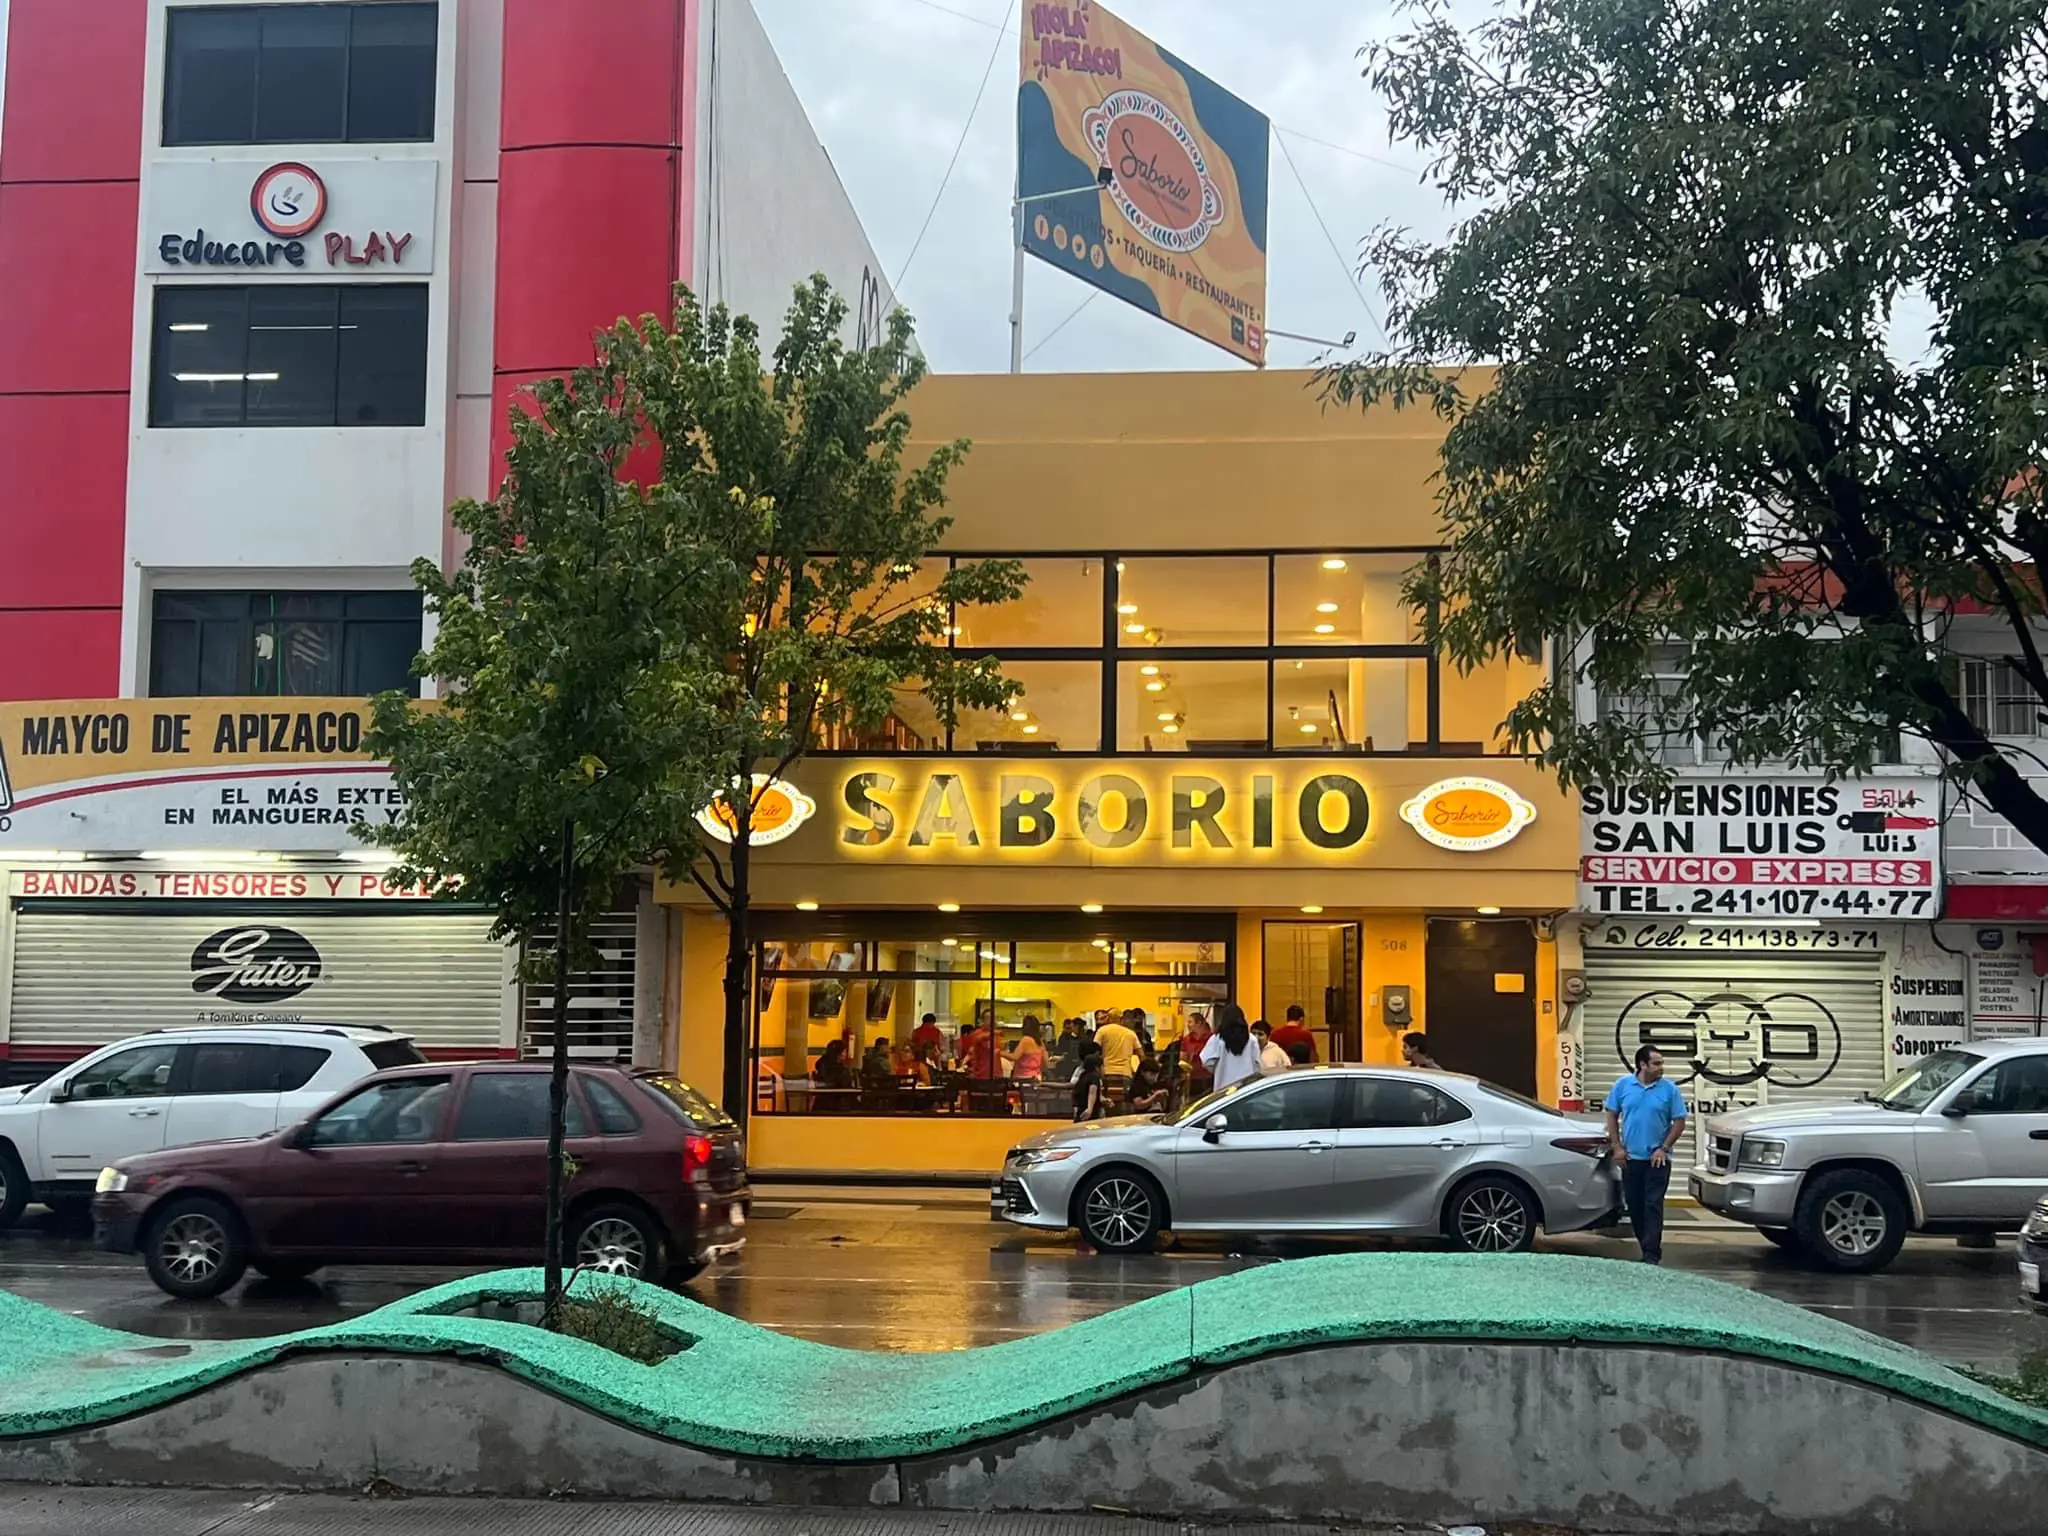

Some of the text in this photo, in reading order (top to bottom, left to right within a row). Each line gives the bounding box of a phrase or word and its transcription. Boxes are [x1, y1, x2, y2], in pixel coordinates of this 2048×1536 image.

[159, 228, 412, 267] Educare PLAY
[1123, 238, 1177, 280] TAQUERÍA
[1184, 271, 1256, 321] RESTAURANTE
[22, 711, 361, 755] MAYCO DE APIZACO
[221, 788, 250, 805] EL
[267, 781, 319, 805] MÁS
[1582, 784, 1840, 817] SUSPENSIONES
[165, 808, 194, 825] EN
[213, 808, 365, 825] MANGUERAS
[841, 771, 1371, 849] SABORIO
[1593, 821, 1826, 854] SAN LUIS
[24, 872, 147, 897] BANDAS,
[155, 874, 308, 897] TENSORES
[324, 875, 344, 897] Y
[1588, 858, 1922, 885] SERVICIO EXPRESS
[1593, 885, 1685, 912] TEL.
[1381, 939, 1408, 951] 508
[1634, 924, 1688, 947] Cel.
[192, 930, 322, 994] Gates
[1893, 974, 1964, 996] SUSPENSION
[197, 1012, 205, 1022] A
